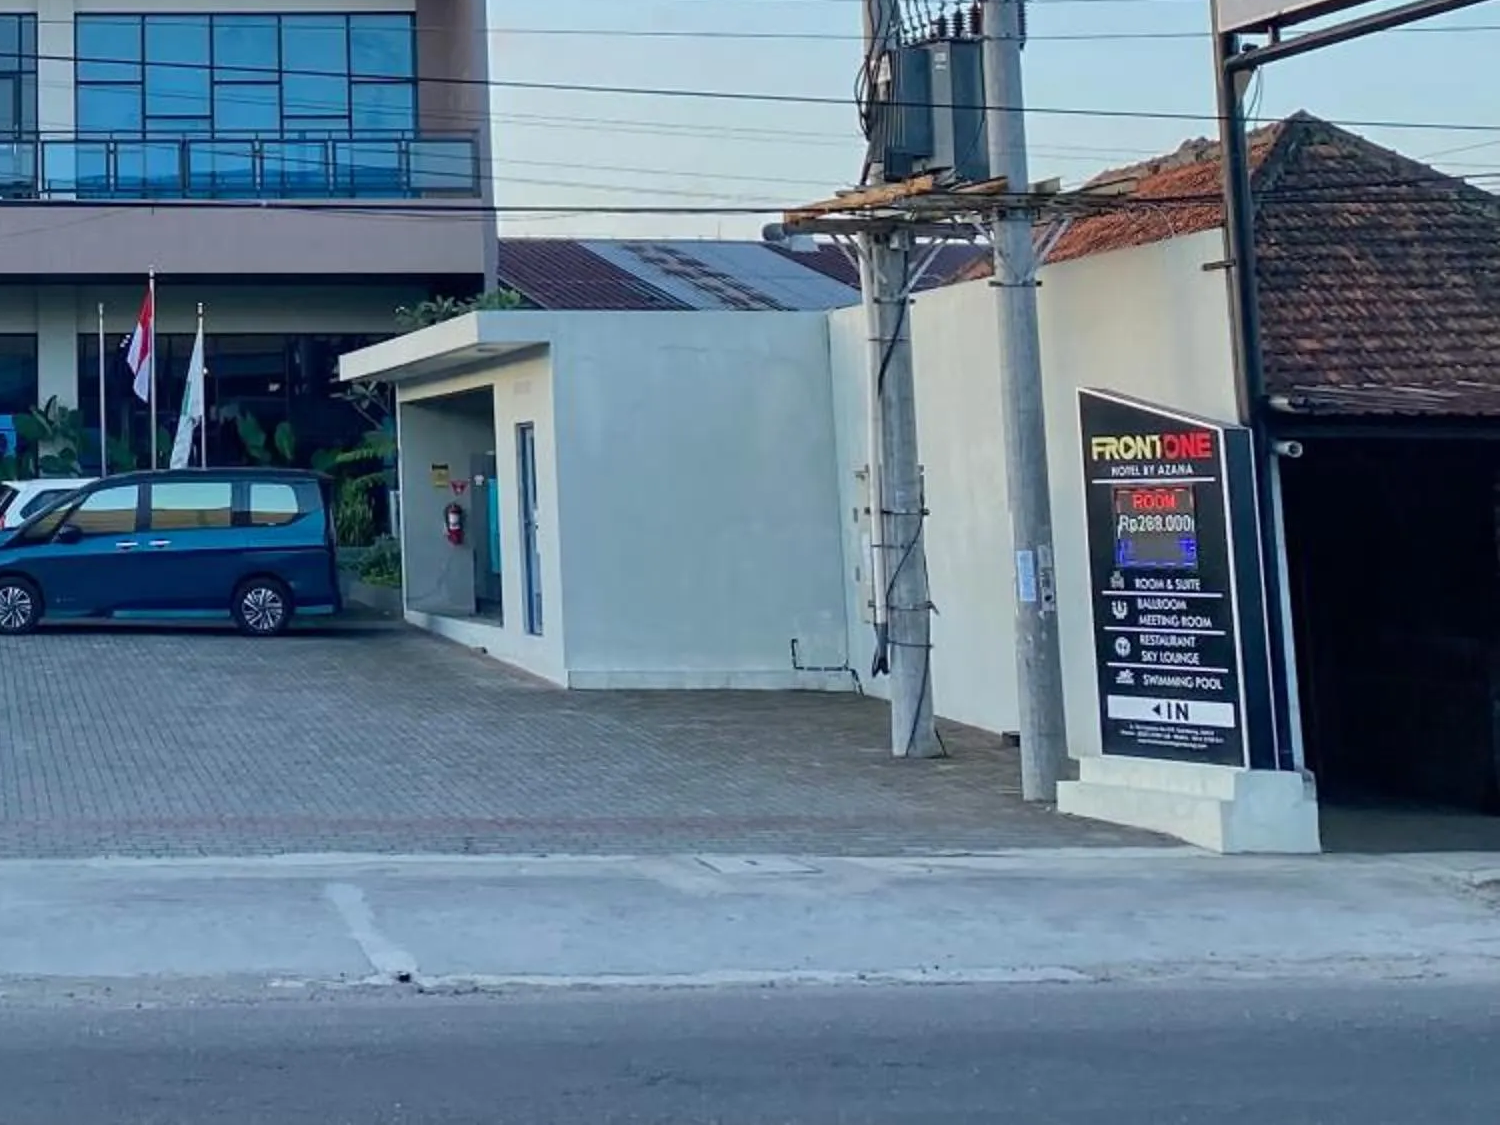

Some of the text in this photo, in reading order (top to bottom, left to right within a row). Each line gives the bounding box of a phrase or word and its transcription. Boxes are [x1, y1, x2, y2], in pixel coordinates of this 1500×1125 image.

[1111, 465, 1141, 477] HOTEL
[1158, 462, 1194, 476] AZANA
[1133, 493, 1176, 509] ROOM
[1134, 578, 1201, 591] ROOM & SUITE
[1137, 598, 1187, 610] BALLROOM
[1139, 615, 1212, 628] MEETING ROOM
[1139, 634, 1196, 647] RESTAURANT
[1141, 650, 1200, 665] SKY LOUNGE
[1143, 674, 1223, 690] SWIMMING POOL
[1166, 701, 1189, 721] IN
